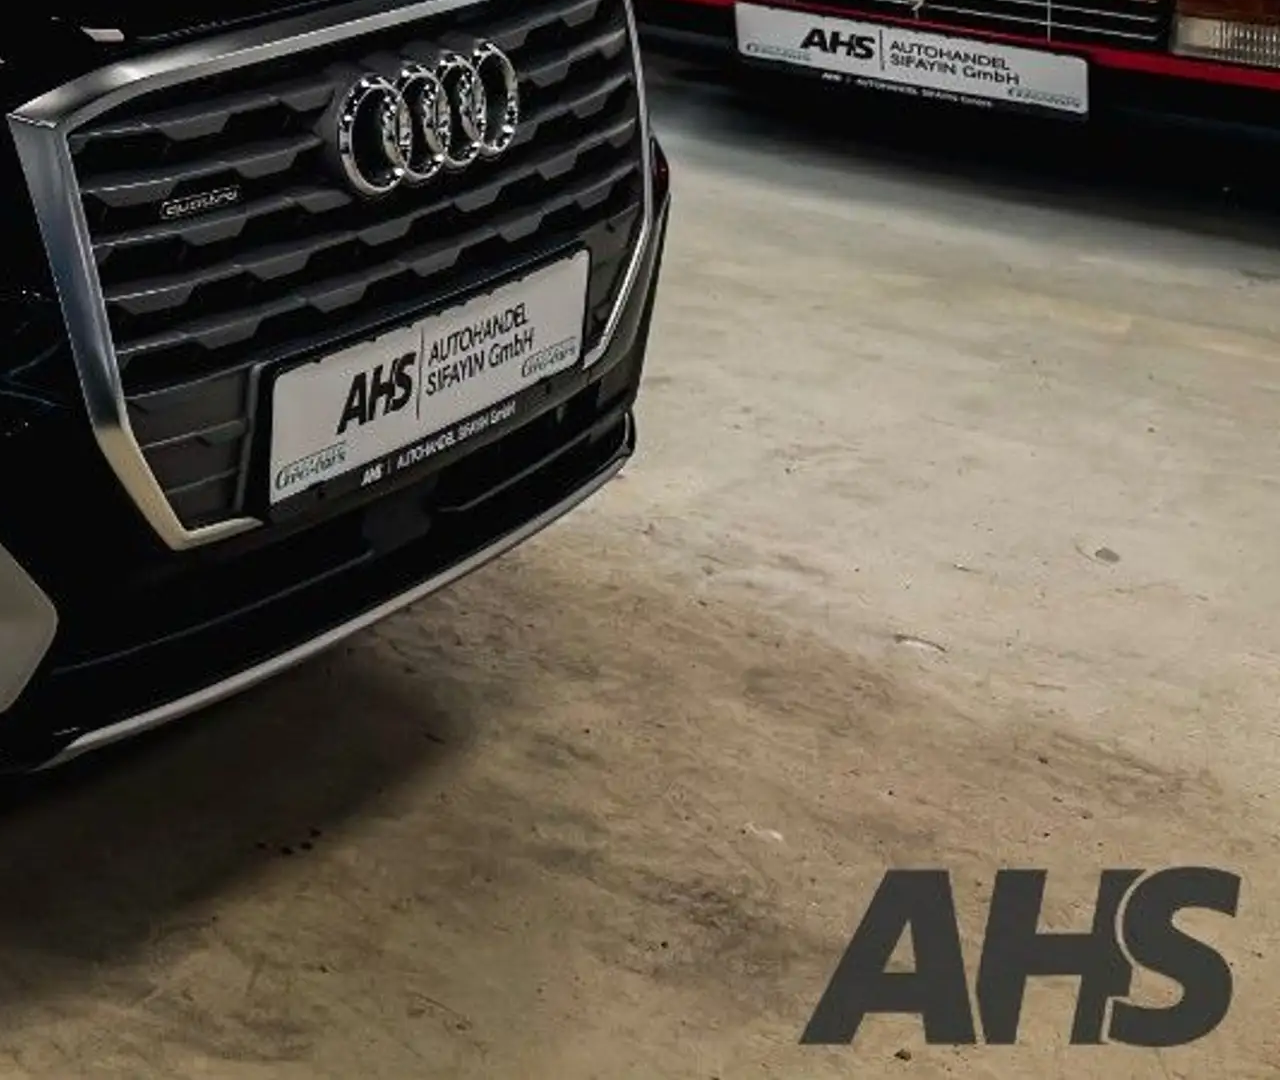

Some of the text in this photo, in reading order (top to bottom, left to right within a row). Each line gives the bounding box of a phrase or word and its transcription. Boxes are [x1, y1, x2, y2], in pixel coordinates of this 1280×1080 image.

[800, 27, 876, 59] AHS
[890, 40, 1009, 70] AUTOHANDEL
[890, 52, 1020, 85] SIFAYIN GmbH
[428, 303, 529, 366] AUTOHANDEL
[425, 350, 485, 396] SIFAYIN
[490, 327, 535, 369] GmbH
[336, 351, 417, 435] AHS
